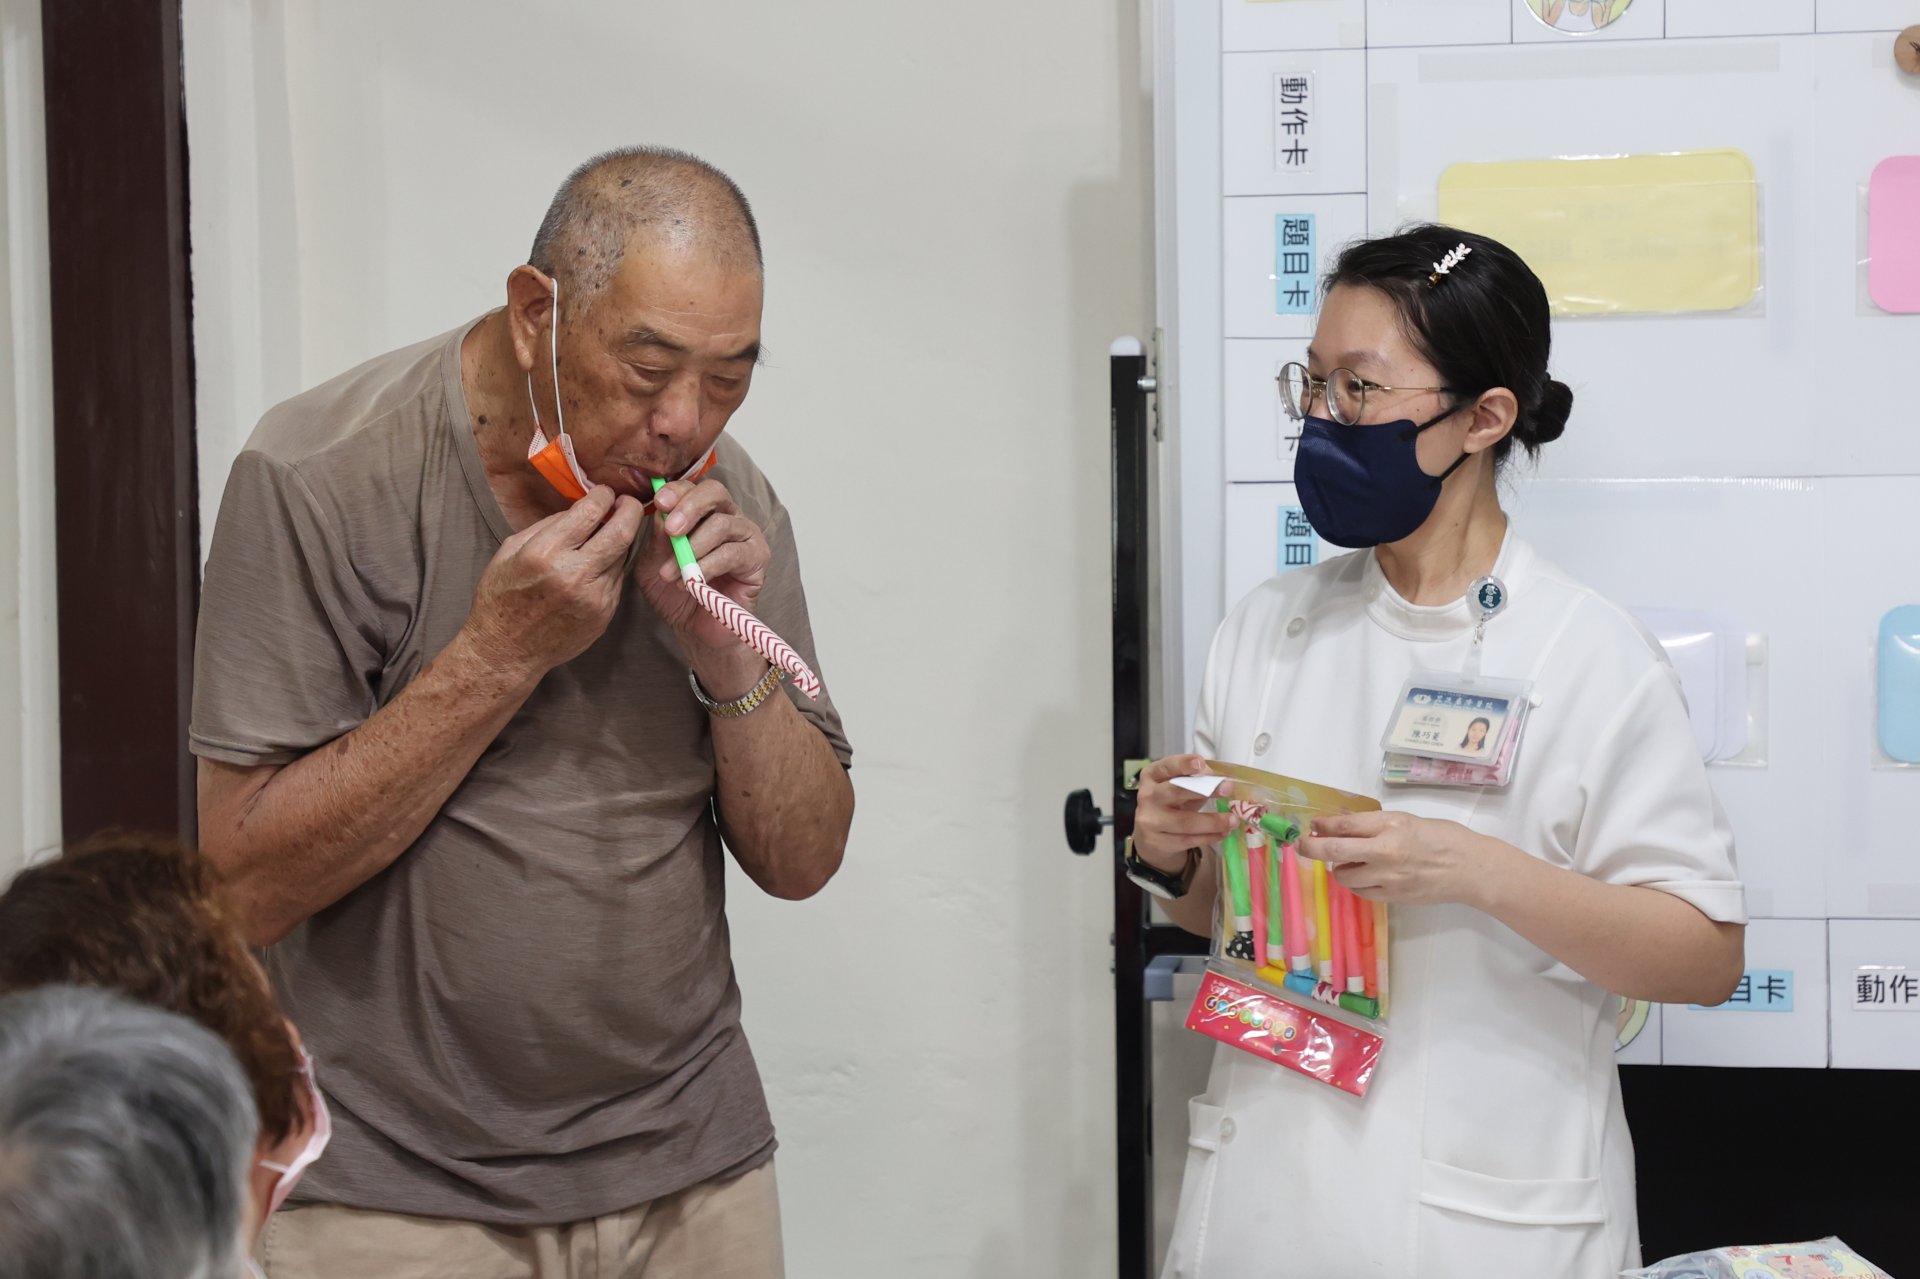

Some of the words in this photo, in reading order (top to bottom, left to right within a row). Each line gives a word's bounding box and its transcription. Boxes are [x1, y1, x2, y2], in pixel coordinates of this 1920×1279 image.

[1280, 77, 1309, 166] 動作卡
[1283, 219, 1310, 307] 題目卡
[1856, 973, 1919, 1004] 動作
